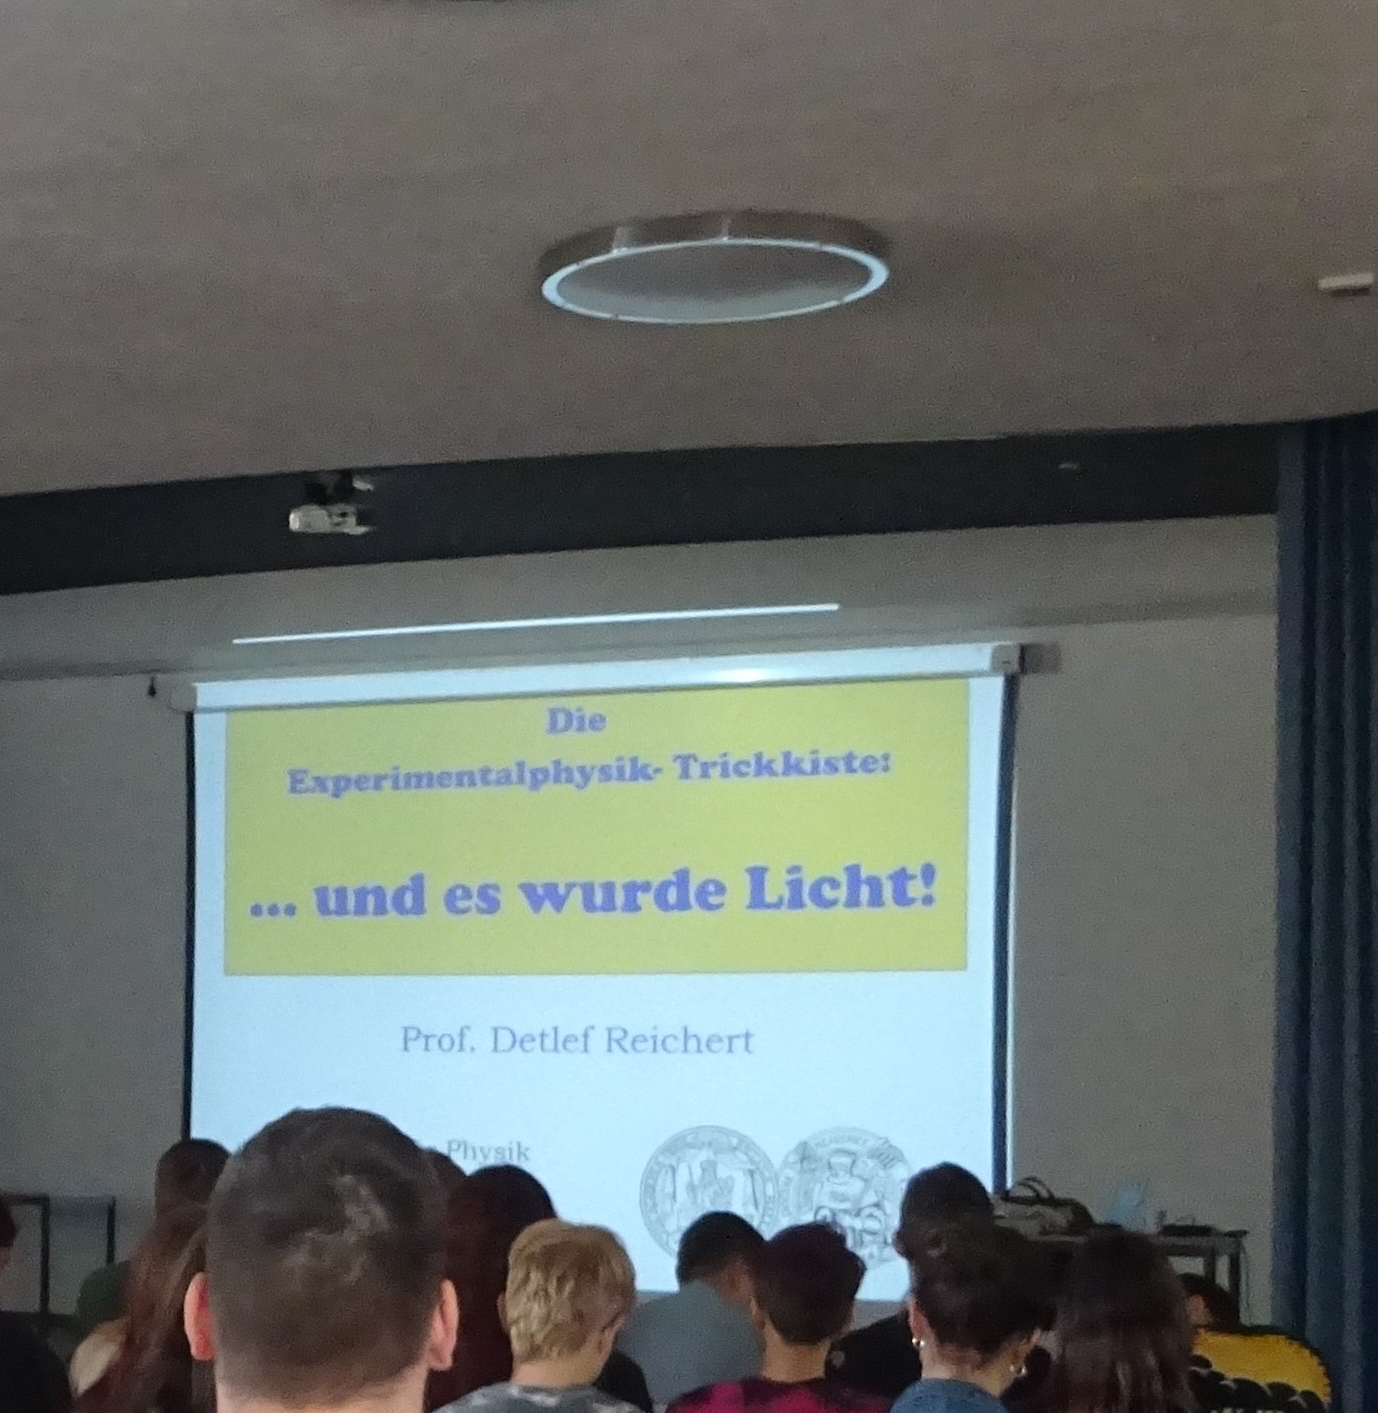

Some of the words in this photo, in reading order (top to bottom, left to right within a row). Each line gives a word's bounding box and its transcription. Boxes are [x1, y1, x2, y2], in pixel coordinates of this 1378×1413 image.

[546, 706, 607, 734] Die
[288, 755, 663, 799] Experimentalphysik-
[672, 750, 891, 781] Trickkiste:
[314, 872, 427, 917] und
[444, 882, 502, 915] es
[517, 866, 727, 914] wurde
[745, 862, 936, 911] Licht!
[401, 1025, 475, 1054] Prof.
[490, 1025, 595, 1054] Detlef
[605, 1025, 755, 1054] Reichert
[447, 1139, 532, 1166] Physik
